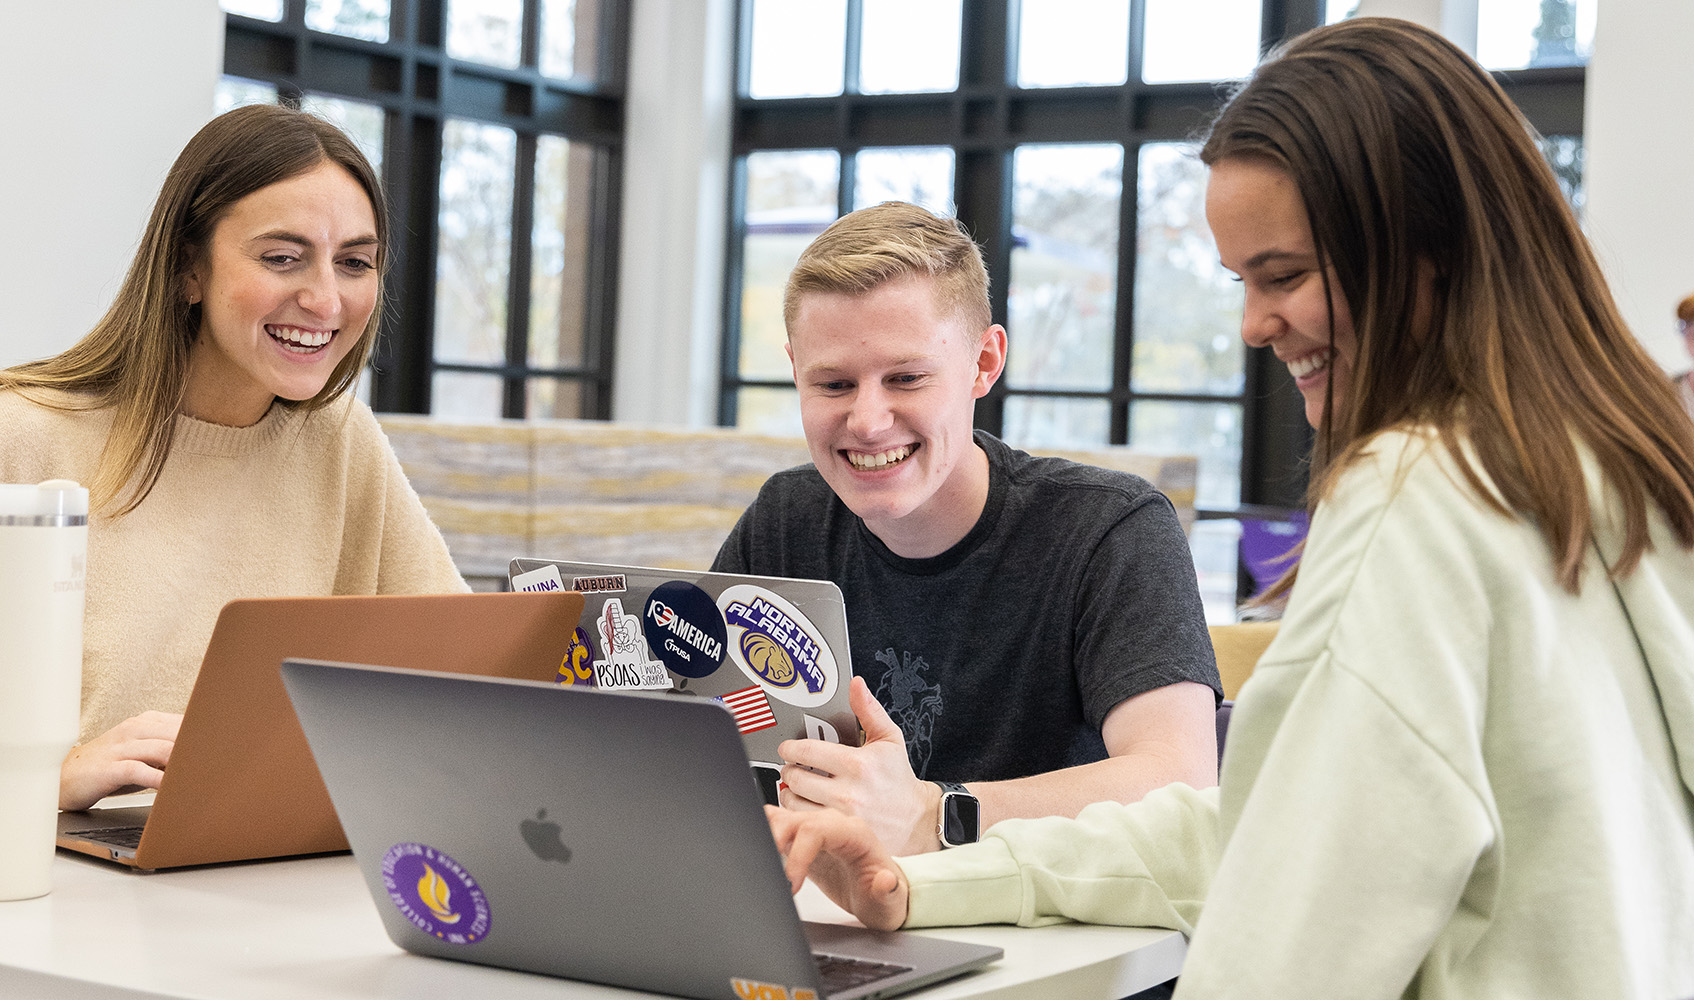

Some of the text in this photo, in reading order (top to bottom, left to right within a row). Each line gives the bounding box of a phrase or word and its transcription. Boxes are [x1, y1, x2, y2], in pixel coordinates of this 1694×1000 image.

[574, 577, 624, 592] AUBURN
[667, 614, 722, 662] AMERICA
[727, 602, 824, 690] ALABAMA
[751, 598, 819, 660] NORTH
[667, 640, 691, 662] TPUSA
[597, 663, 641, 687] PSOAS
